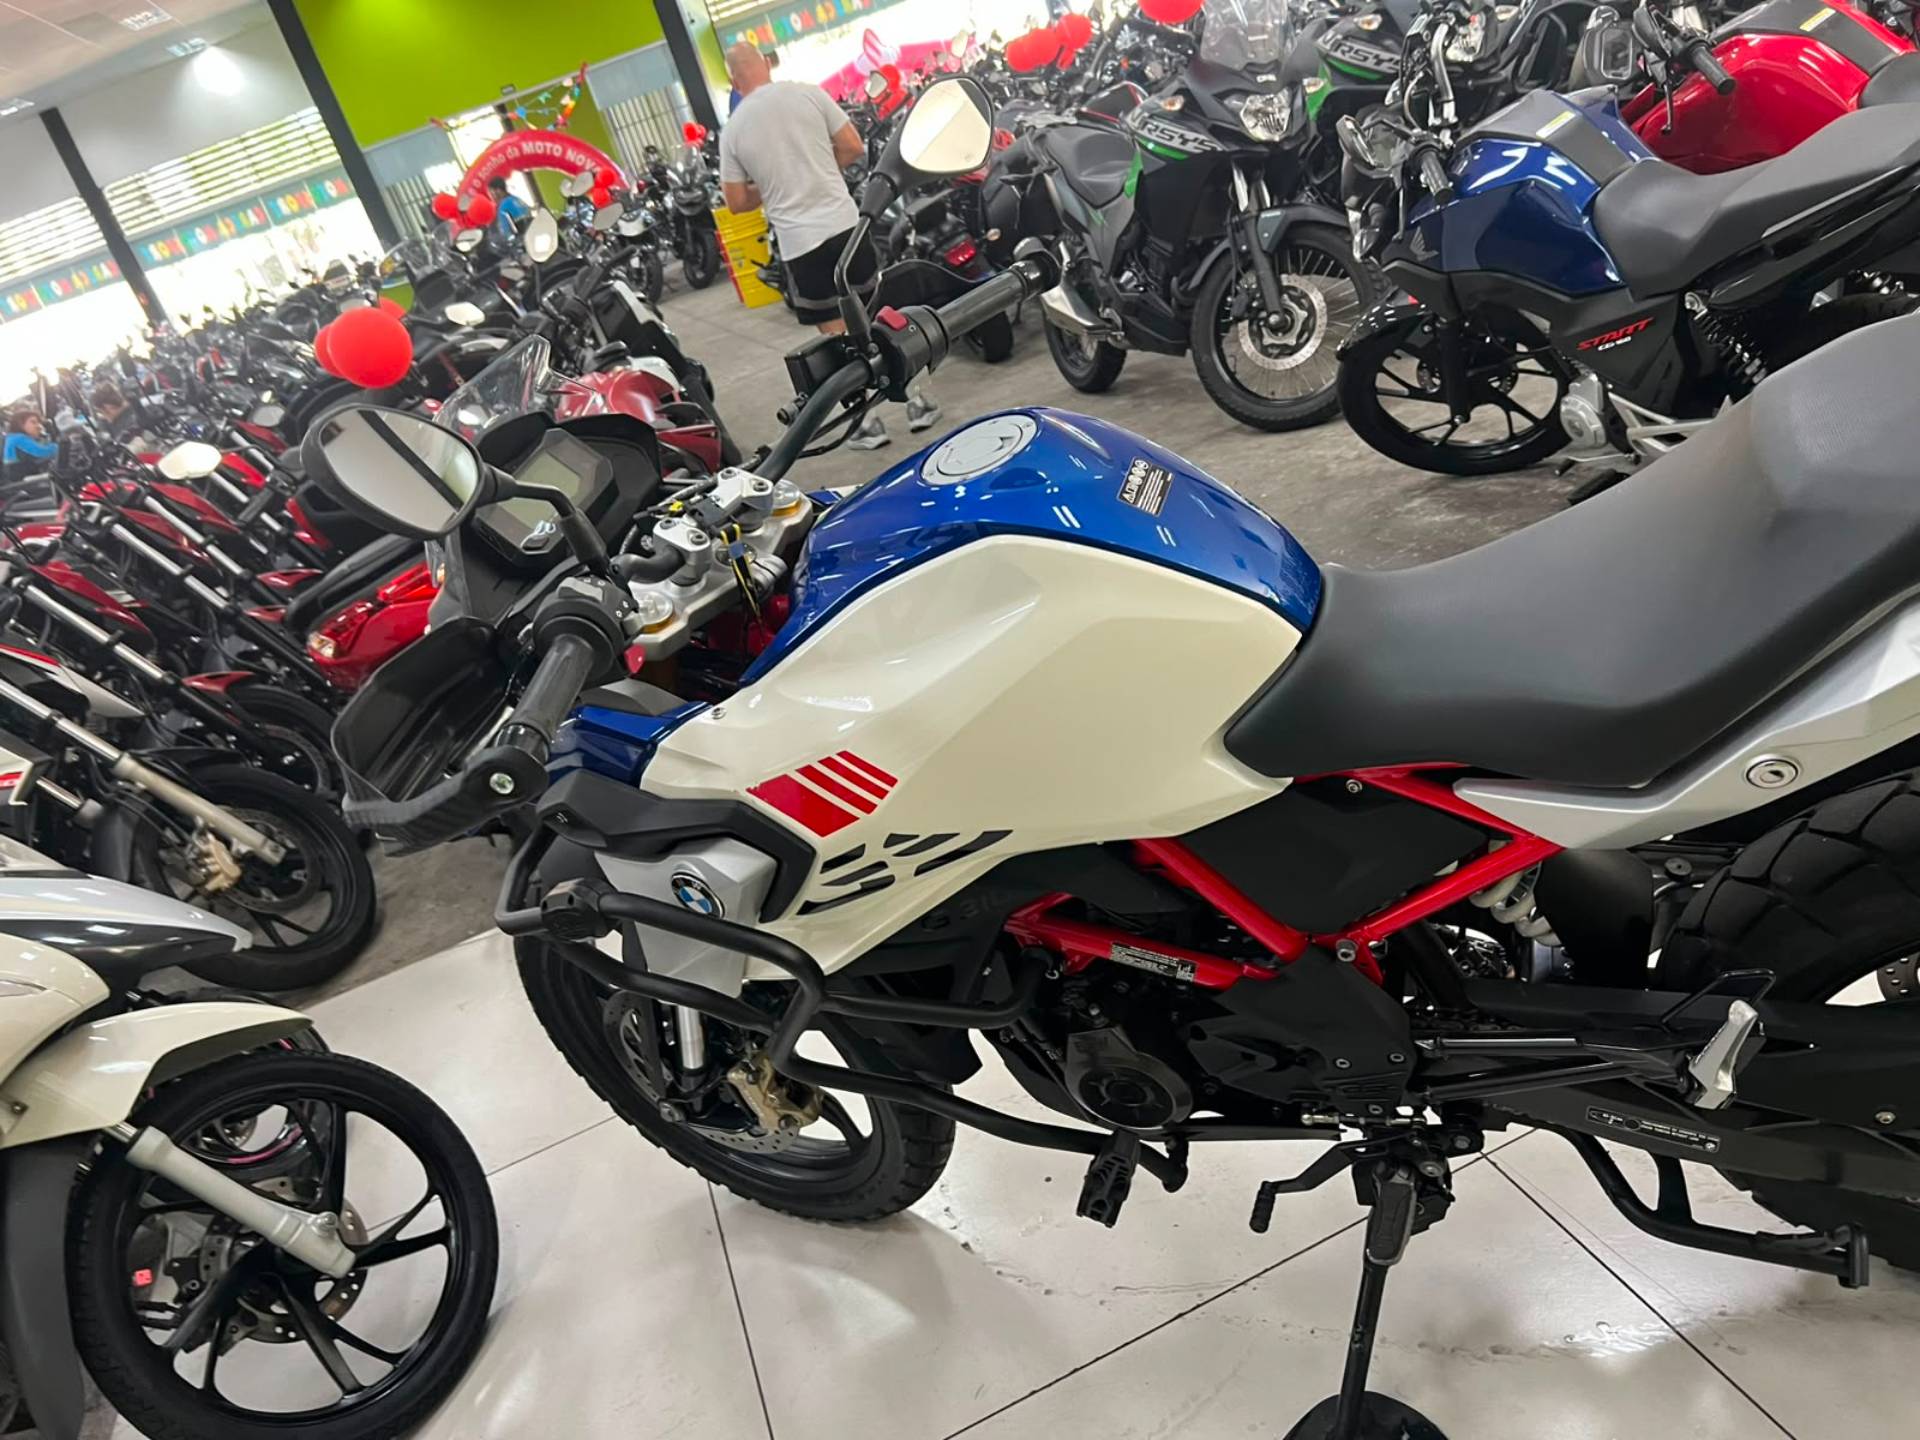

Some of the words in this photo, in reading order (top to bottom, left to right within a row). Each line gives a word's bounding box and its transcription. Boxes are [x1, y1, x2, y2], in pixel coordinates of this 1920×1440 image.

[478, 153, 506, 179] sonho
[506, 145, 520, 159] da
[522, 141, 563, 157] MOTO
[1577, 316, 1655, 351] START
